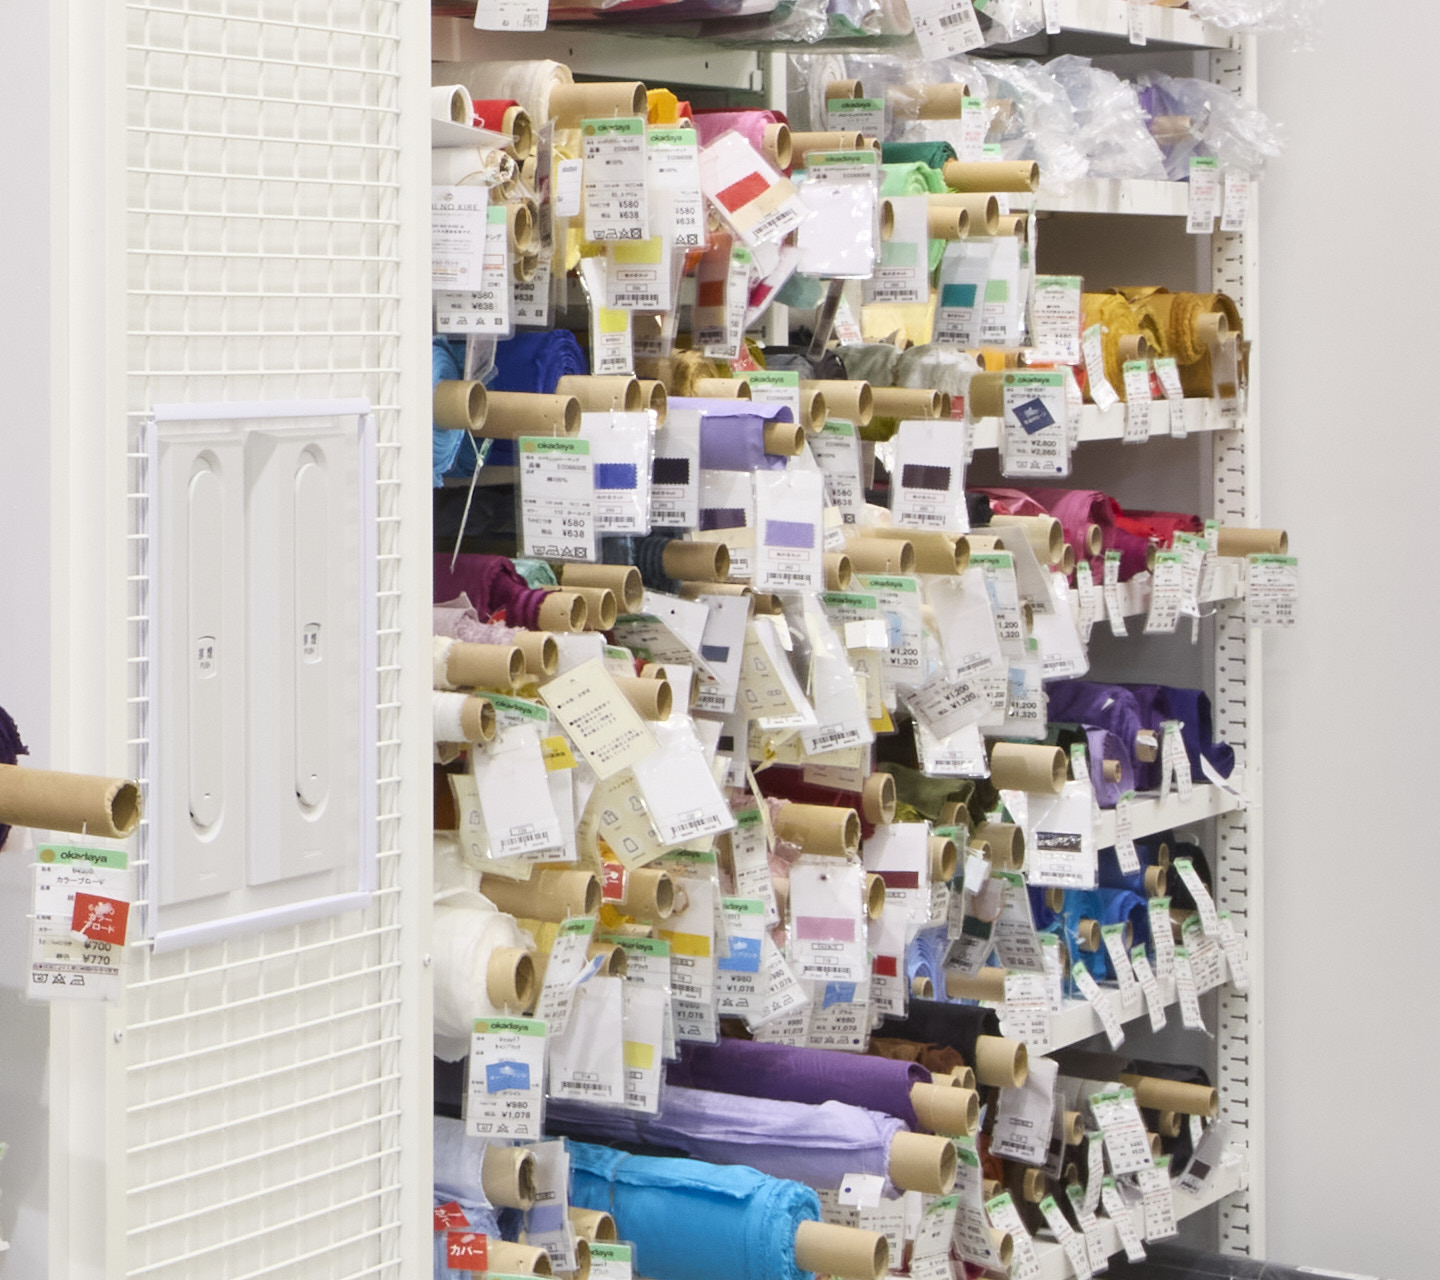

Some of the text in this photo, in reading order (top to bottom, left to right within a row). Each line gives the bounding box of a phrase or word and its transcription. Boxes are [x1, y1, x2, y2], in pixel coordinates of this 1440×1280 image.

[619, 201, 639, 210] ¥580
[619, 211, 639, 219] ¥638
[82, 955, 111, 966] ¥770
[450, 1243, 484, 1257] カバー
